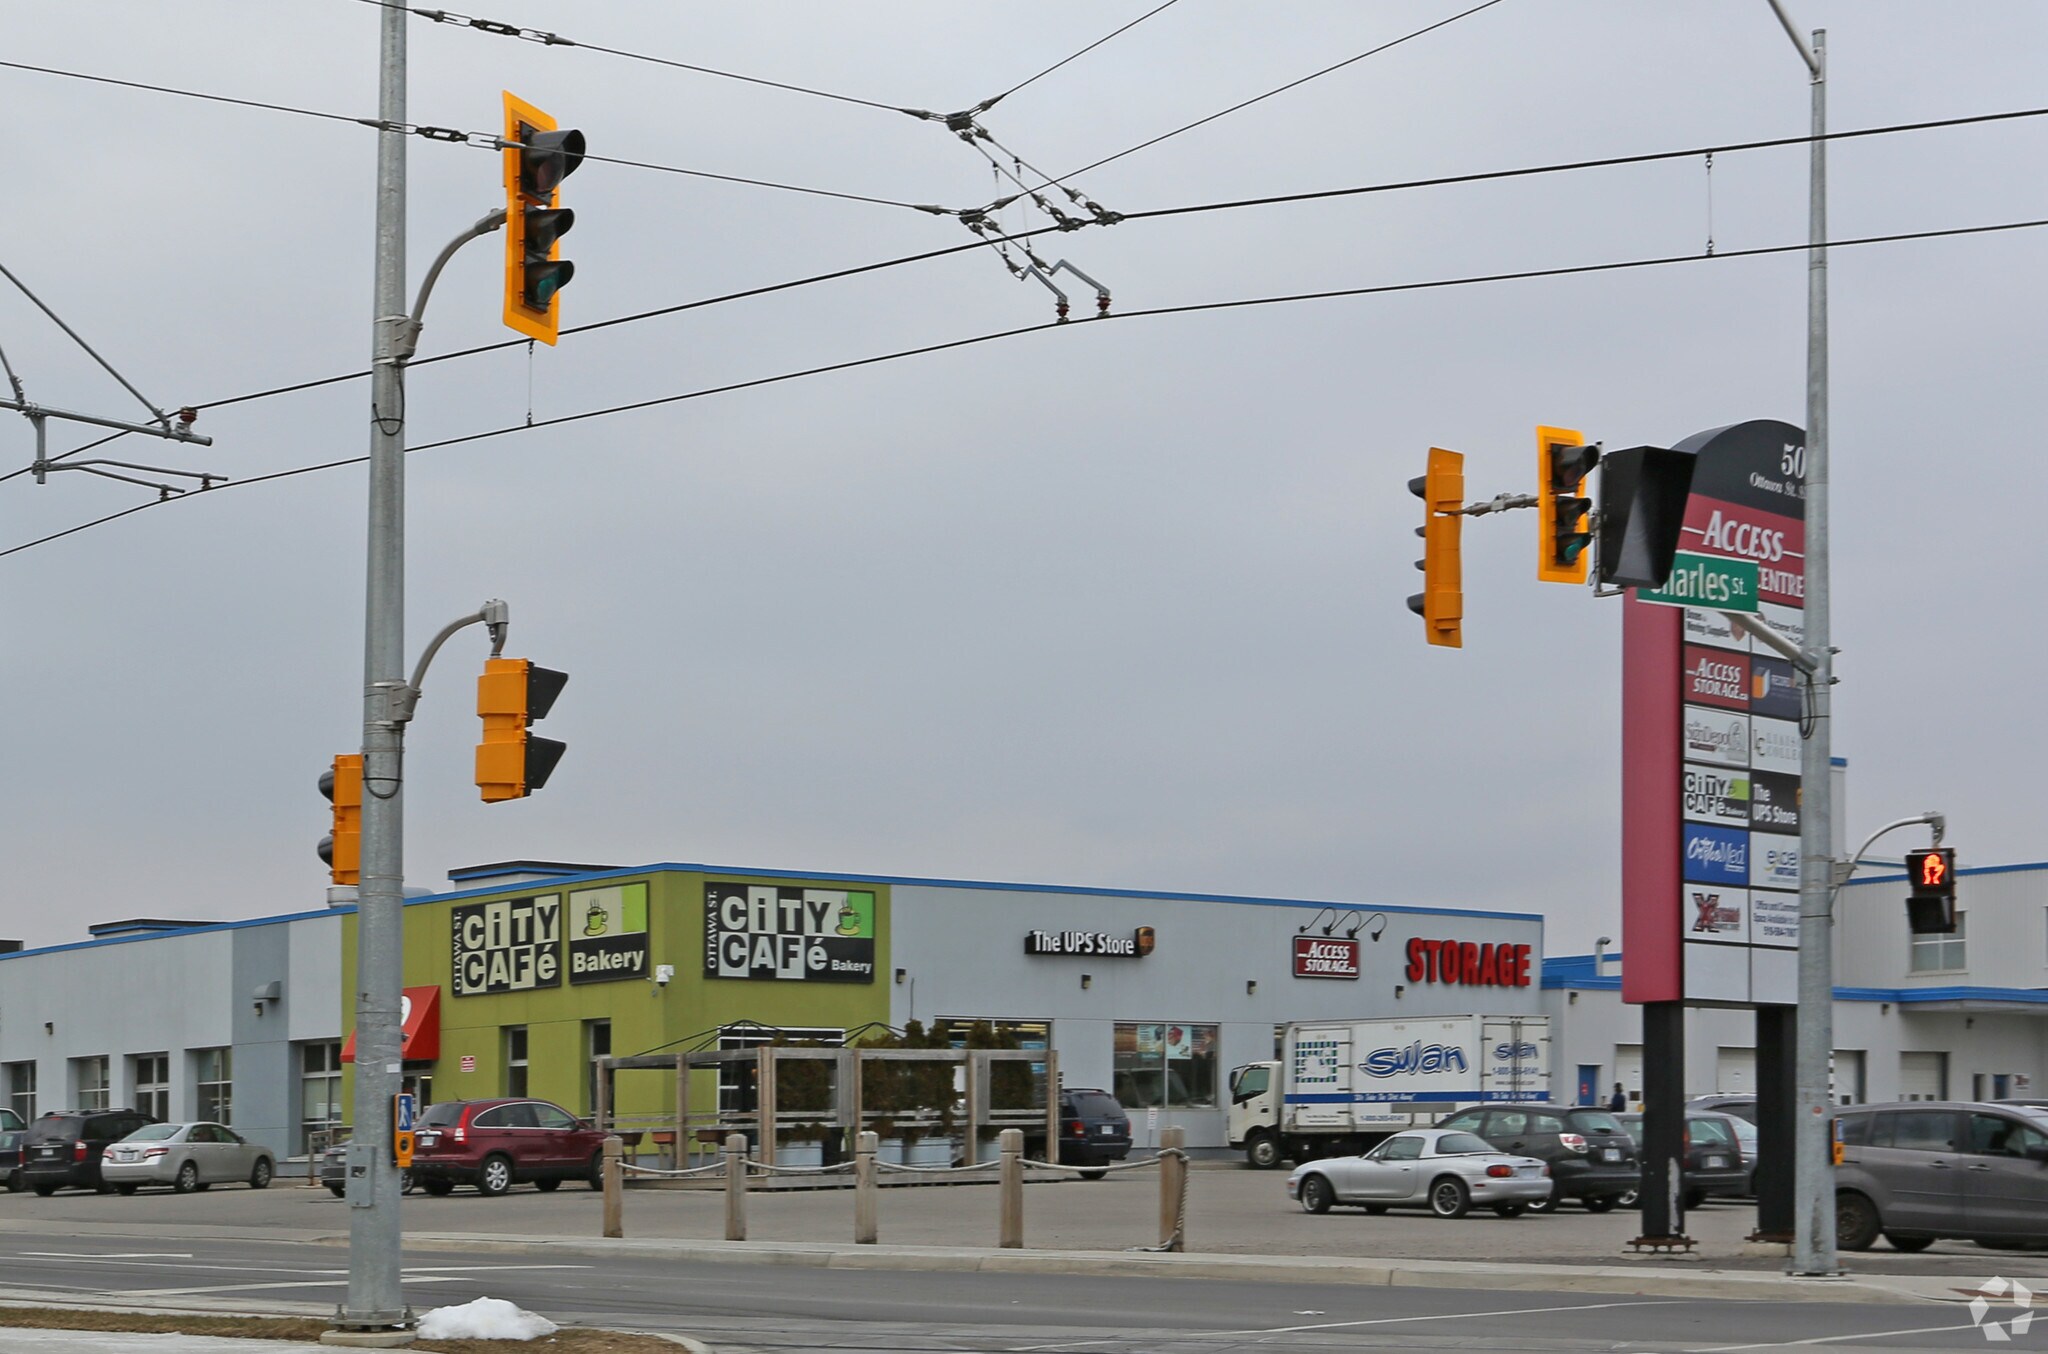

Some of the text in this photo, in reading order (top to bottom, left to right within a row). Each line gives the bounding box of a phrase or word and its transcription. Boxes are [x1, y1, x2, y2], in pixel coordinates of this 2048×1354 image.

[1702, 510, 1784, 562] ACCESS
[1651, 563, 1748, 602] harles St.
[1758, 567, 1804, 598] ENTRE
[1695, 658, 1742, 683] ACCESS
[1753, 783, 1771, 801] The
[1752, 803, 1798, 825] UPS Store
[707, 911, 718, 969] OTTAWA
[722, 934, 872, 974] CAFé Bakery
[1033, 930, 1135, 955] The UPS Store
[1308, 941, 1351, 960] ACCESS
[453, 932, 462, 991] OTTAWA
[464, 944, 557, 989] CAFé
[573, 950, 645, 974] Bakery
[1405, 937, 1532, 987] STORAGE
